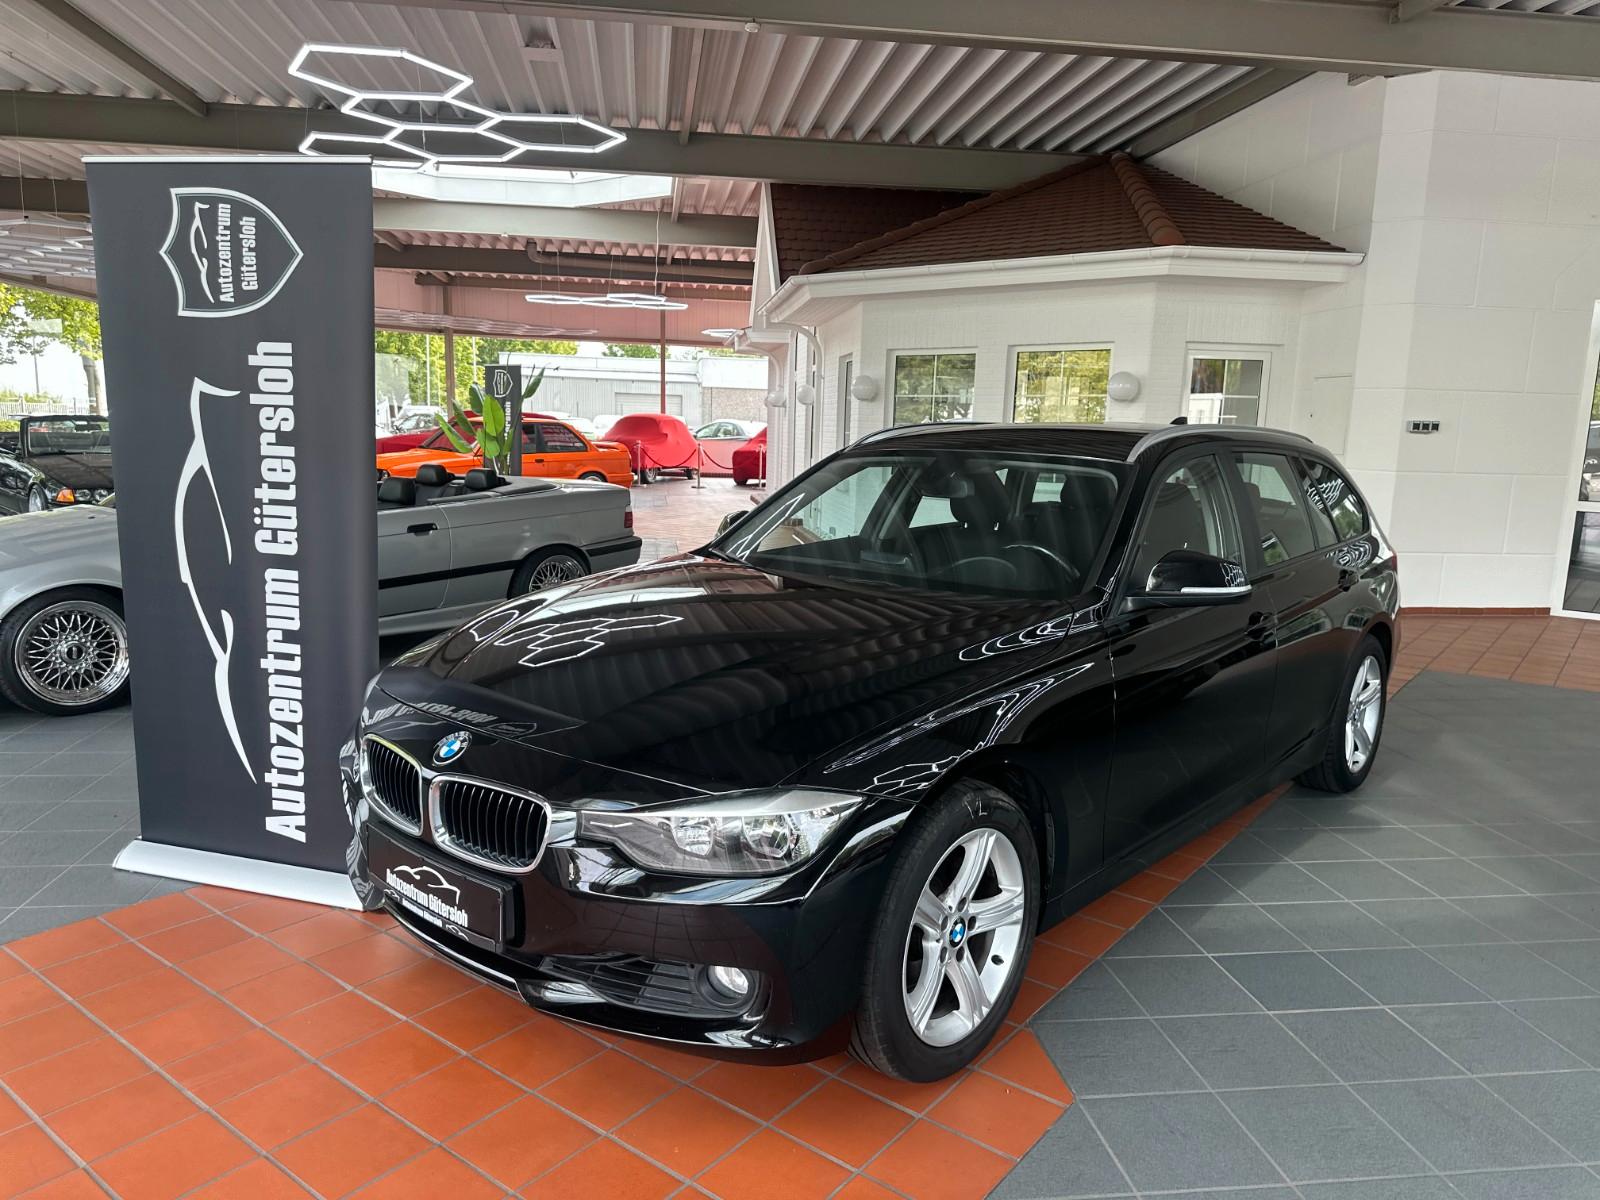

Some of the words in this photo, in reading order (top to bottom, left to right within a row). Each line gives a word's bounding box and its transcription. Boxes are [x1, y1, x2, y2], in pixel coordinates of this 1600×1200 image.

[216, 203, 235, 303] Autozentrum
[239, 216, 259, 291] Gütersloh
[248, 341, 299, 556] Gütersloh
[260, 568, 307, 843] Autozentrum
[428, 893, 468, 928] Gütersloh
